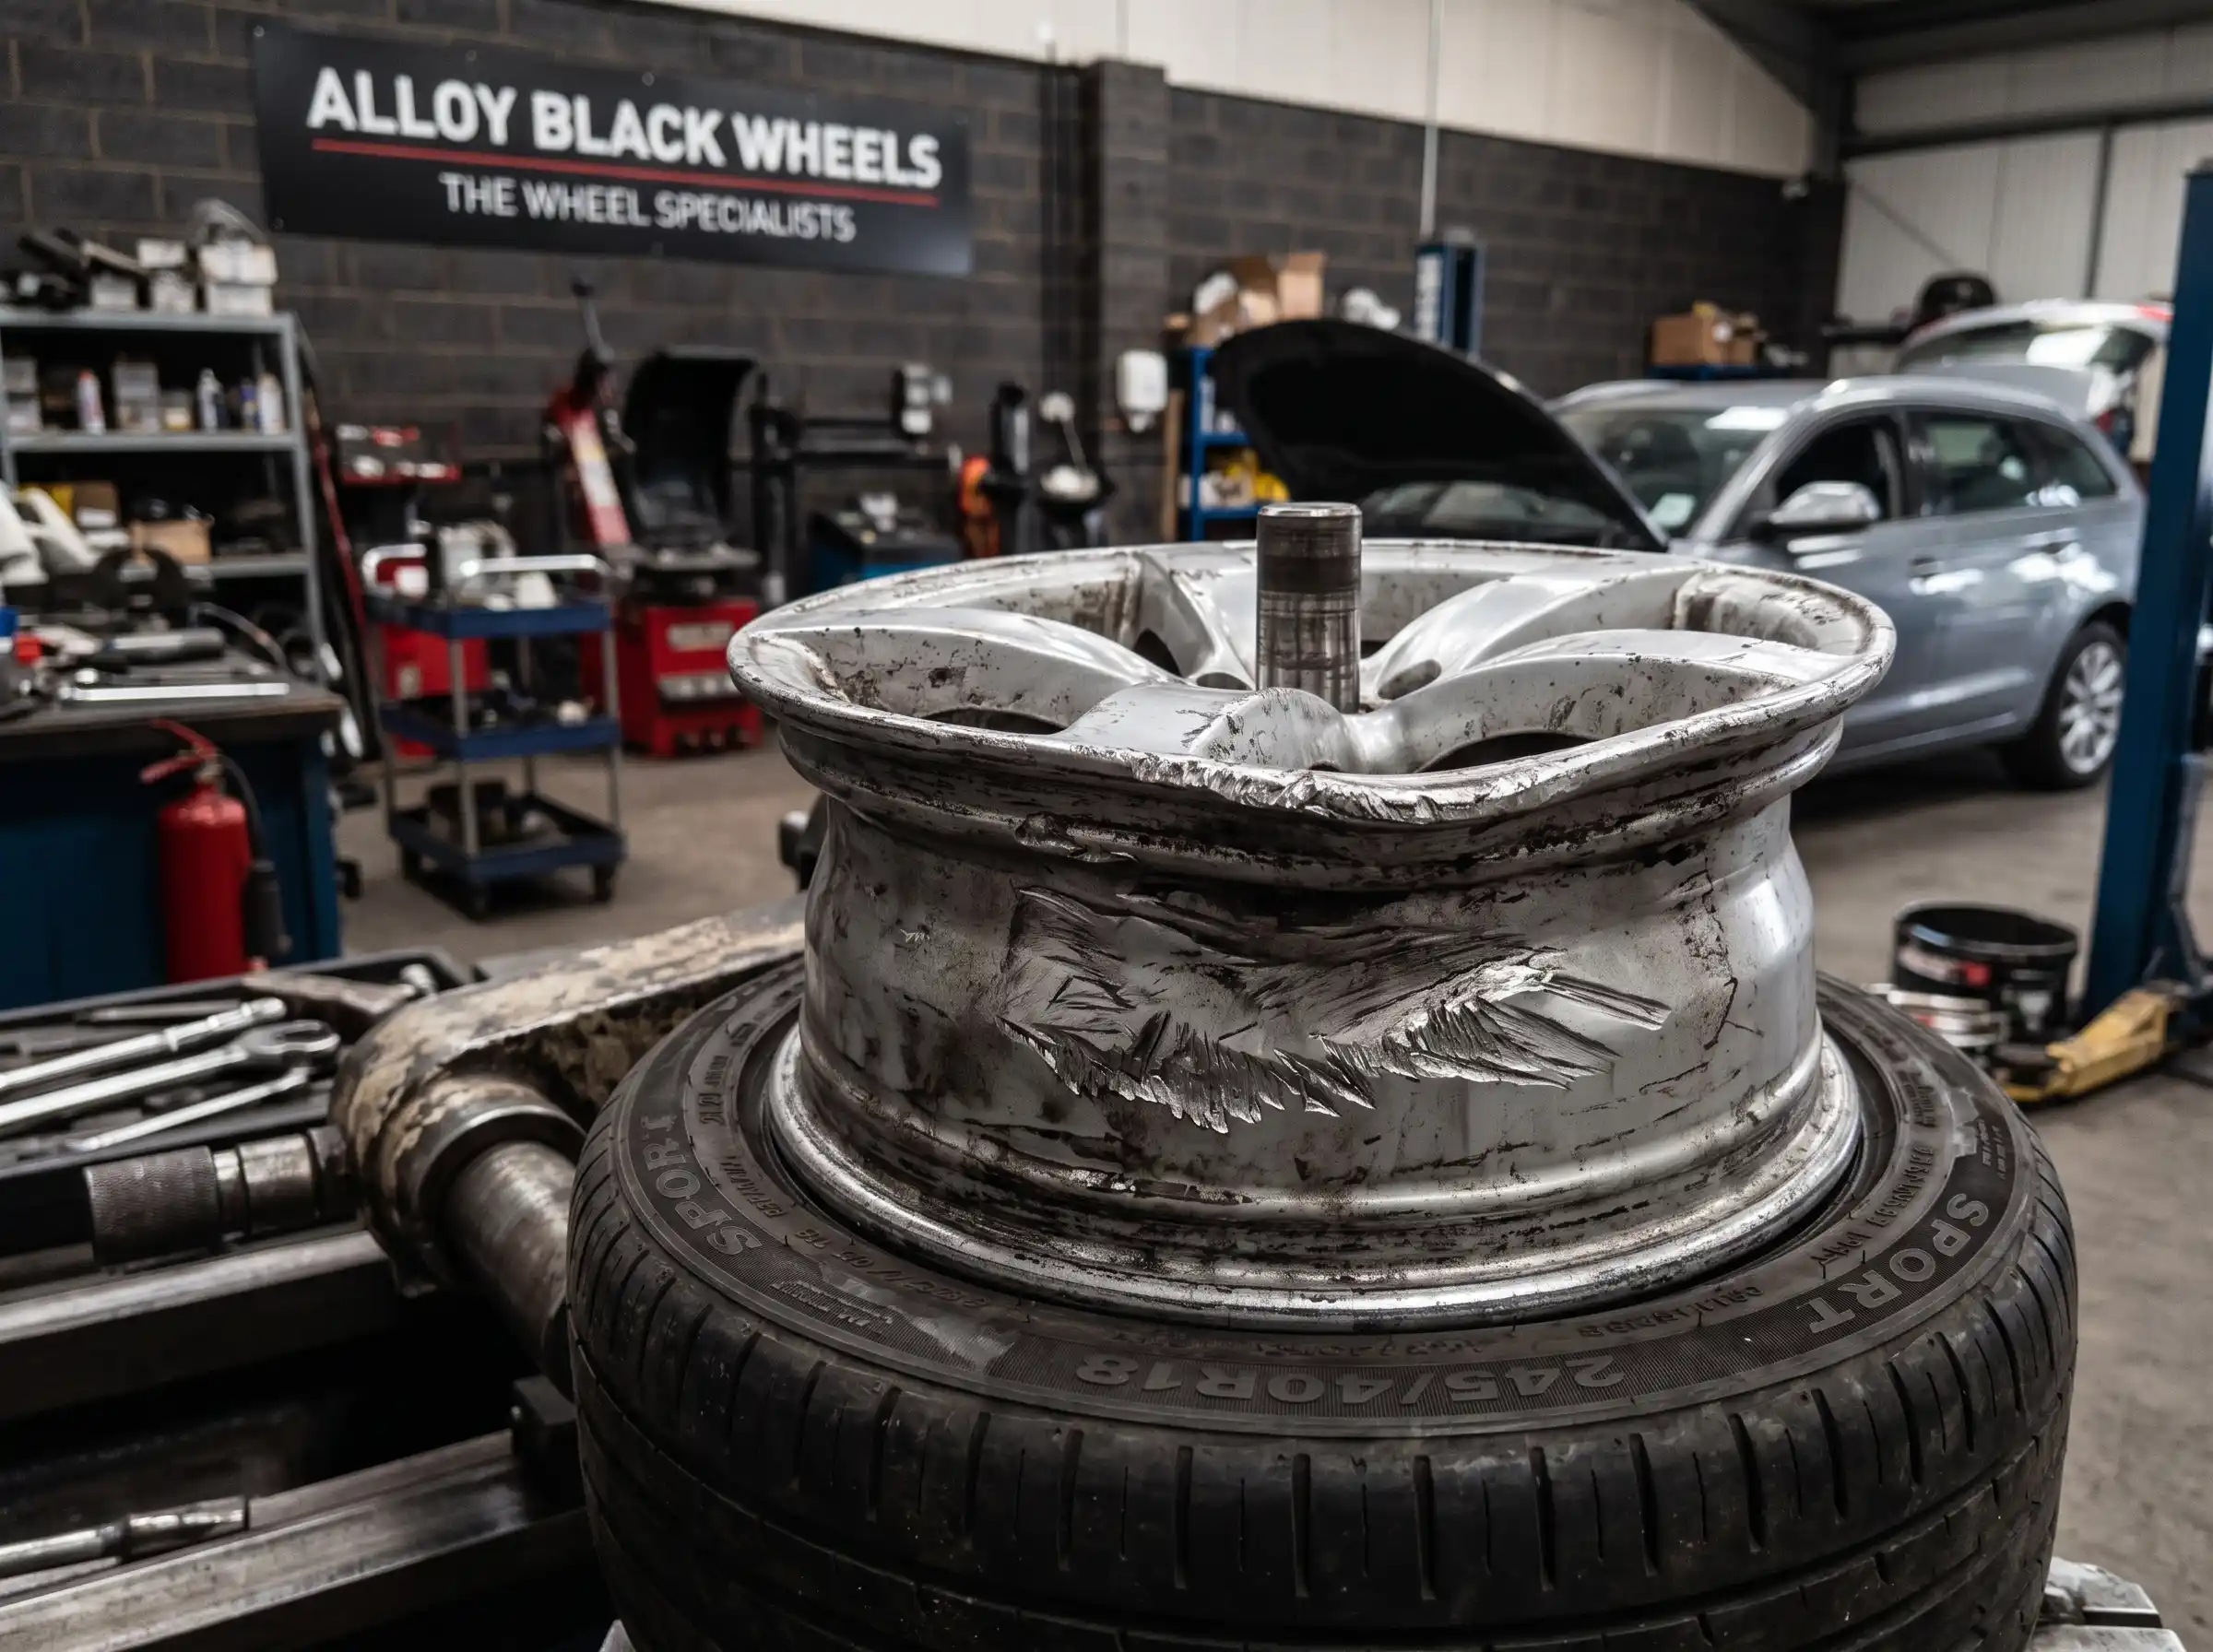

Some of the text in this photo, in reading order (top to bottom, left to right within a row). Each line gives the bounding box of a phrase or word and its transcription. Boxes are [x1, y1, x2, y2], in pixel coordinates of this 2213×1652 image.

[307, 65, 942, 189] ALLOY BLACK WHEELS
[440, 172, 858, 243] THE WHEEL SPECIALISTS
[641, 1114, 763, 1256] SPORT
[1807, 1193, 1989, 1333] SPORT
[1076, 1353, 1626, 1406] 245/40R18
